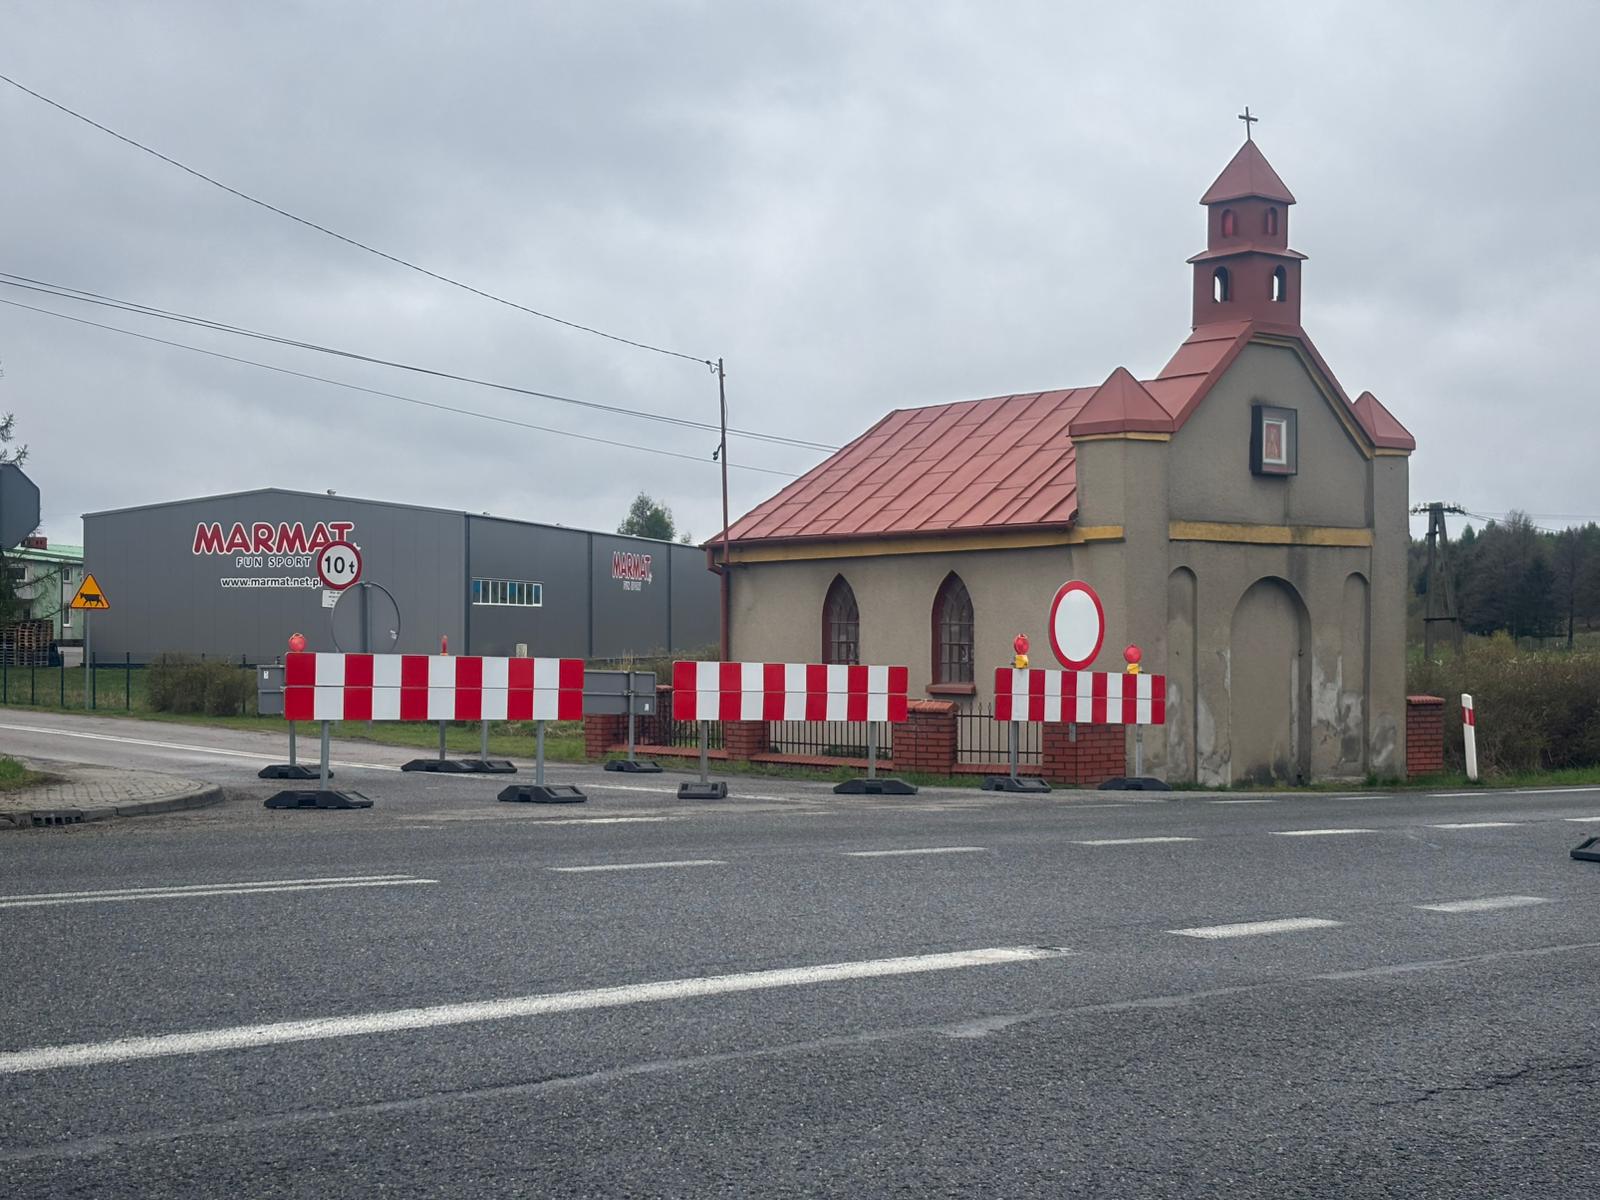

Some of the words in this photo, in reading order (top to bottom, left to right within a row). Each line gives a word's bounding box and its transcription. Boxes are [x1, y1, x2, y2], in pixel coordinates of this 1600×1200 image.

[193, 521, 354, 554] MARMAT
[236, 556, 262, 568] FUN
[269, 556, 312, 568] SPORT
[221, 576, 323, 588] www.marmat.net.pl
